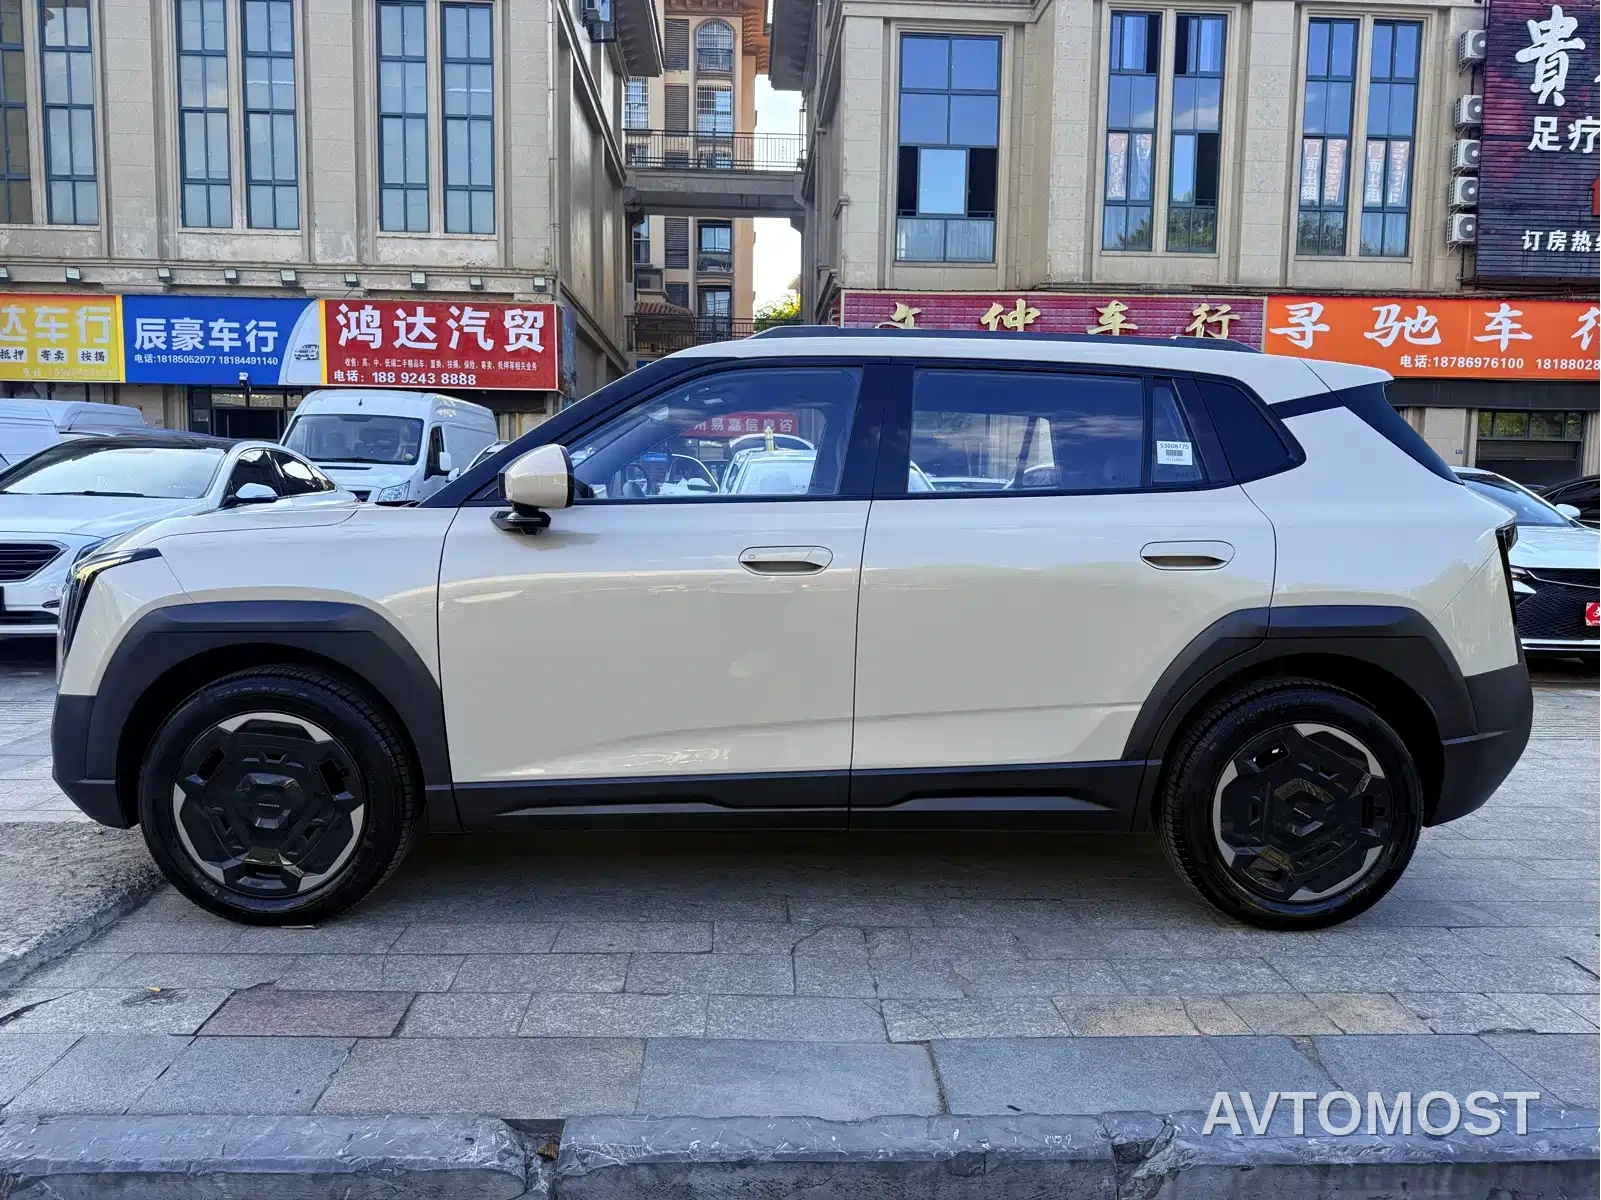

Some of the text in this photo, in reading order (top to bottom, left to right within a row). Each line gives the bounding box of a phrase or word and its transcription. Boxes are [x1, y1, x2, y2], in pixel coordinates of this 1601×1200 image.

[1515, 4, 1600, 107] 貴
[1527, 115, 1600, 153] 足疗
[1521, 230, 1600, 252] 订房热
[134, 317, 279, 353] 辰豪车行
[336, 303, 545, 353] 鸿达汽贸
[0, 348, 105, 362] 抵押 寄卖 按揭
[218, 355, 278, 366] 18184491140
[371, 371, 396, 383] 188
[400, 372, 436, 384] 9243
[441, 373, 477, 386] 8888
